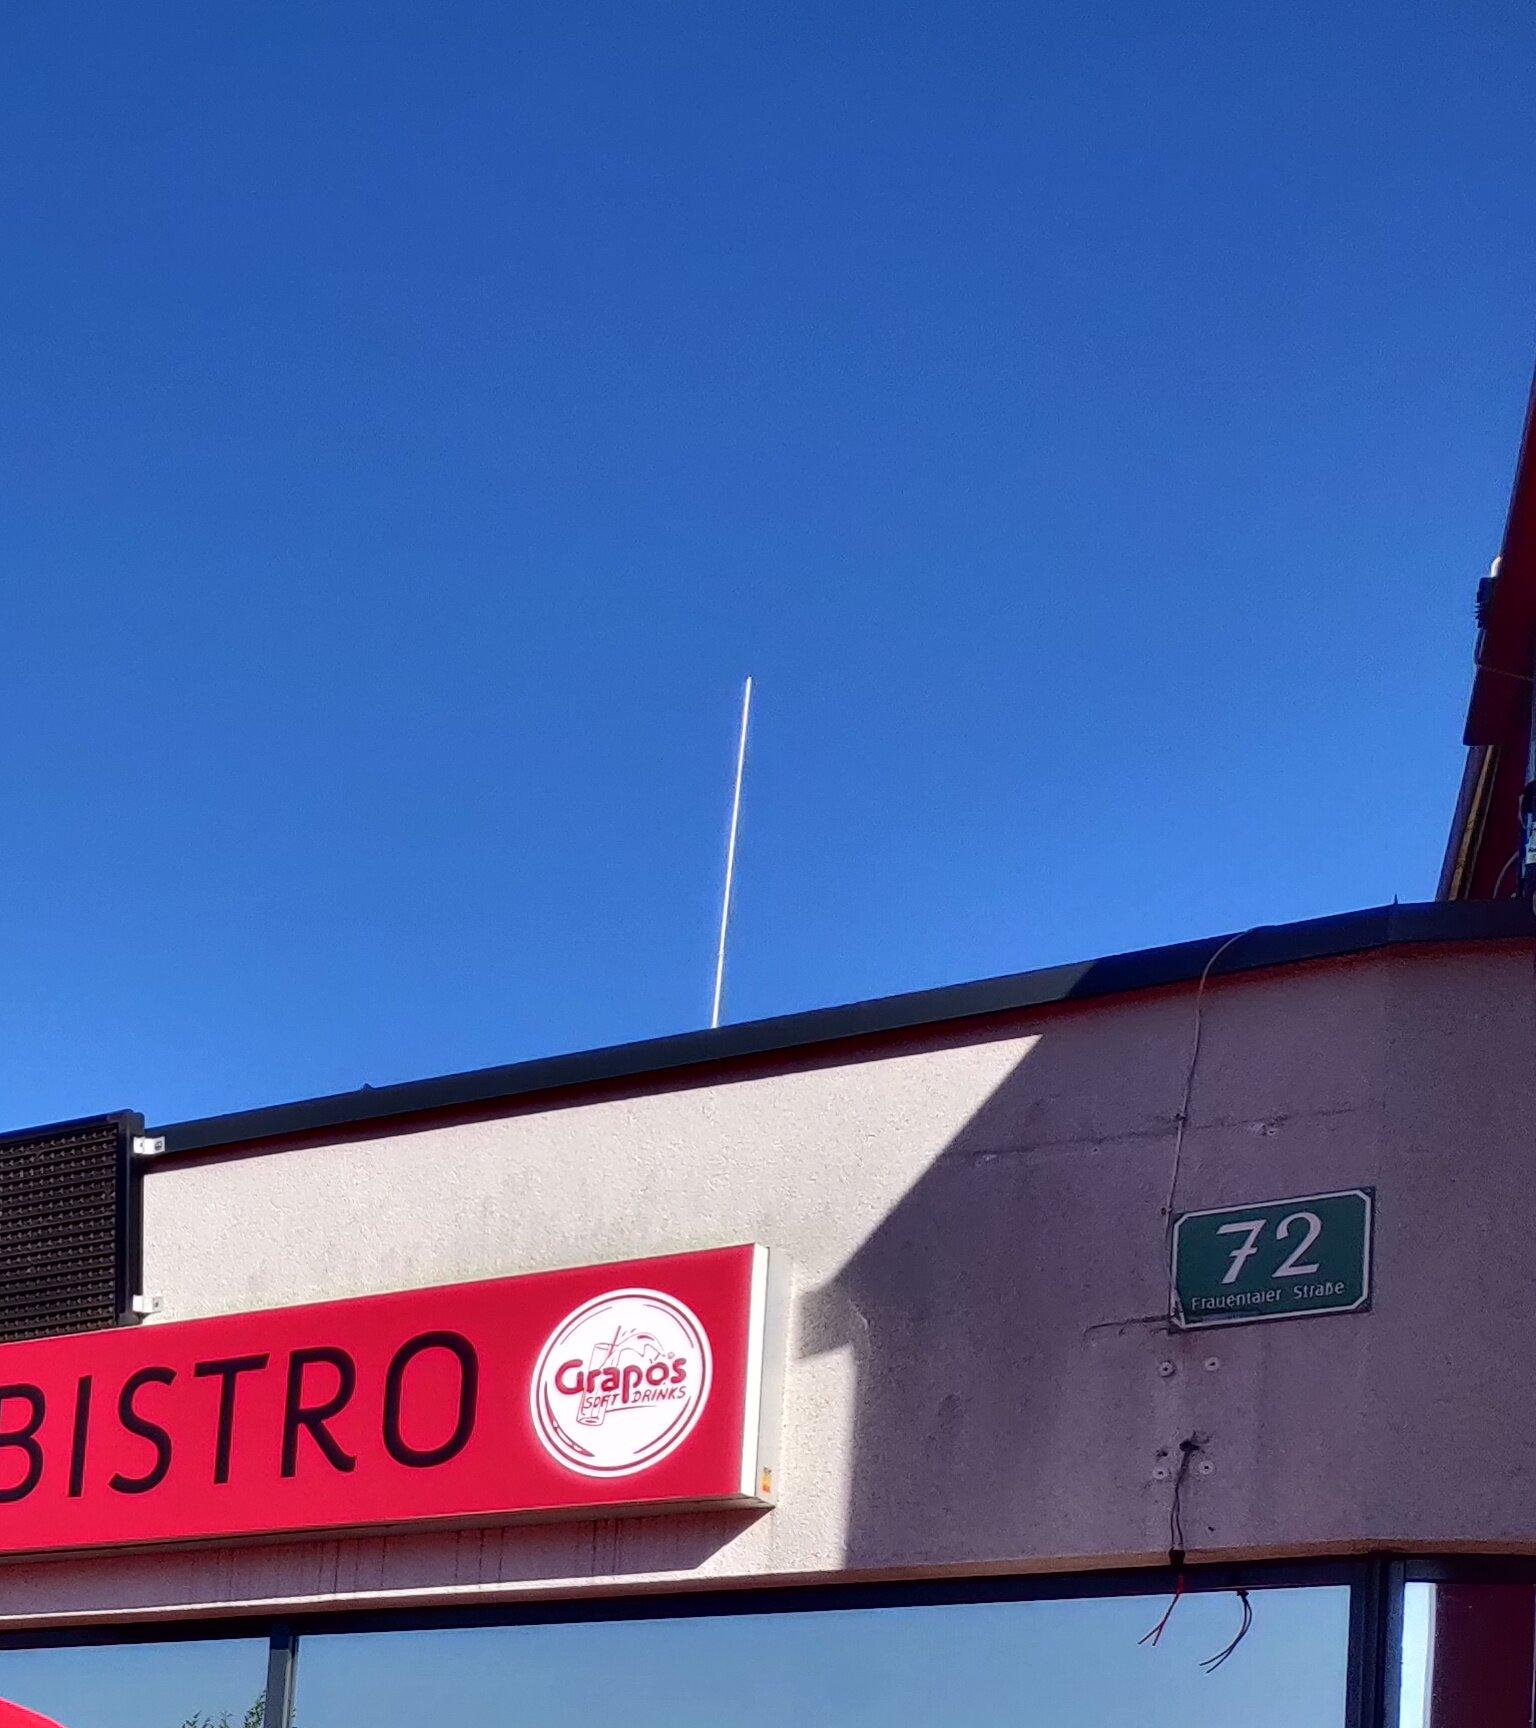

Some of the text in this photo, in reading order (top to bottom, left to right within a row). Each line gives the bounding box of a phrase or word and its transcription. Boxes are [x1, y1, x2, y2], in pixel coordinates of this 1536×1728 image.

[1215, 1211, 1323, 1285] 72
[1293, 1281, 1346, 1300] Straße
[583, 1386, 687, 1409] SOFT DRINKS
